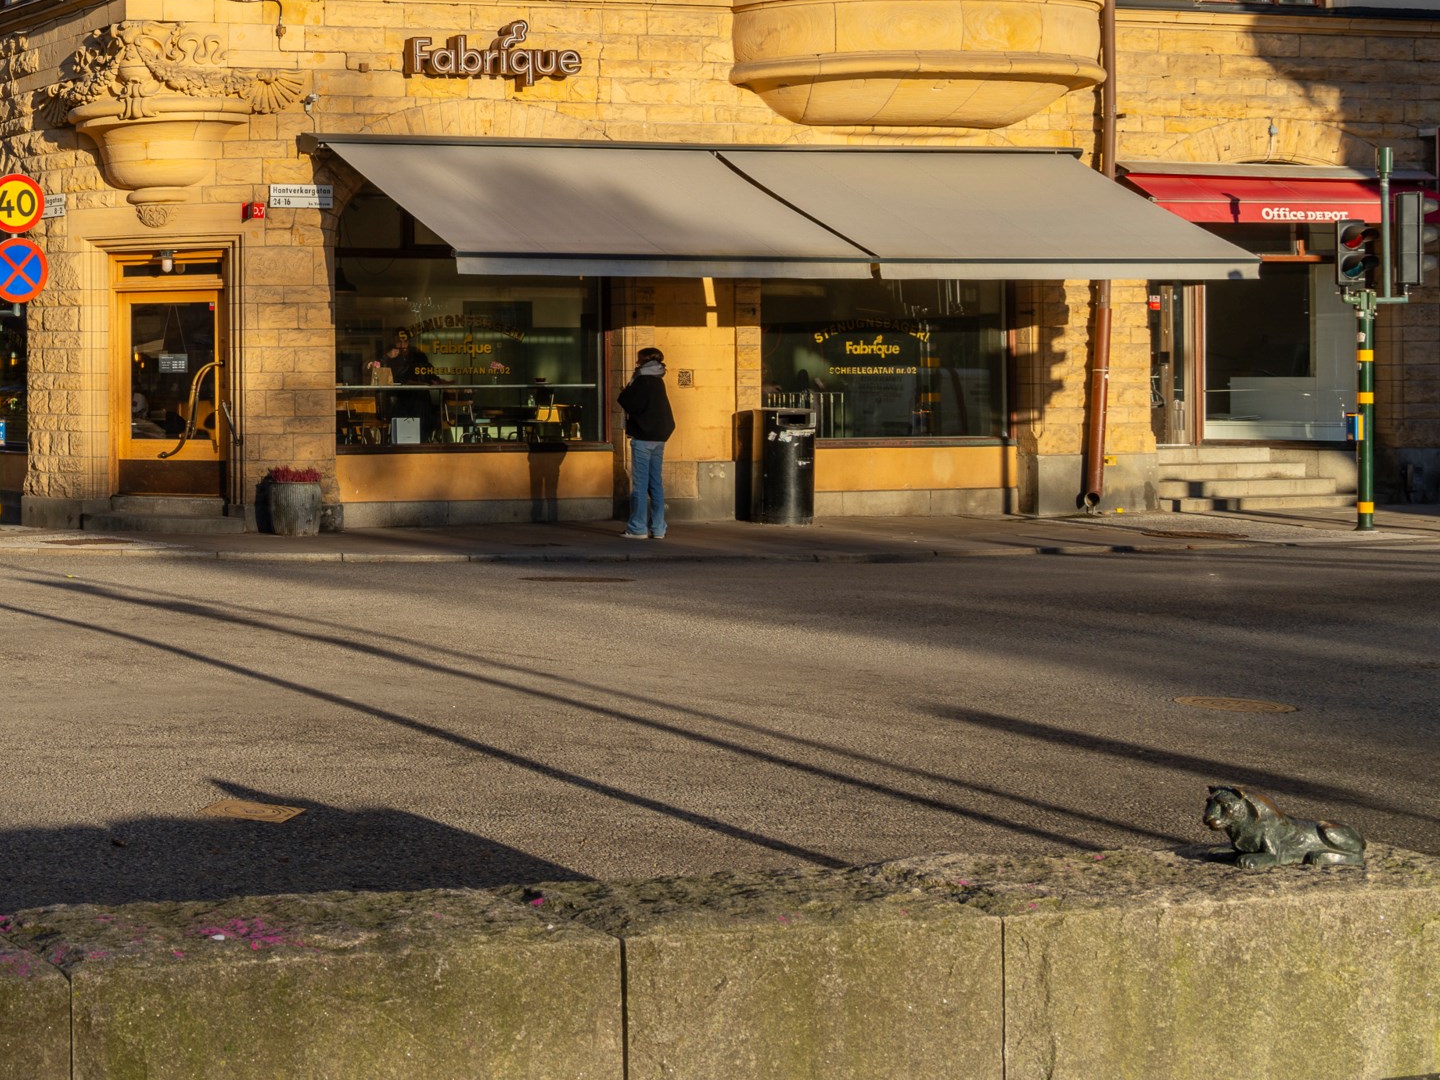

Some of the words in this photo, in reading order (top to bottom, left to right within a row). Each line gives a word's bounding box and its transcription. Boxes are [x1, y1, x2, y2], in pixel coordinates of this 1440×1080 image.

[407, 20, 582, 87] Fabrique
[272, 186, 331, 196] Hantverkargatan
[1261, 207, 1305, 220] Office
[1306, 211, 1349, 220] DEPOT
[433, 333, 492, 358] Fabrique
[845, 334, 901, 359] Fabrique
[414, 366, 486, 375] SCHEELEGATAN
[829, 366, 894, 375] SCHEELEGATAN
